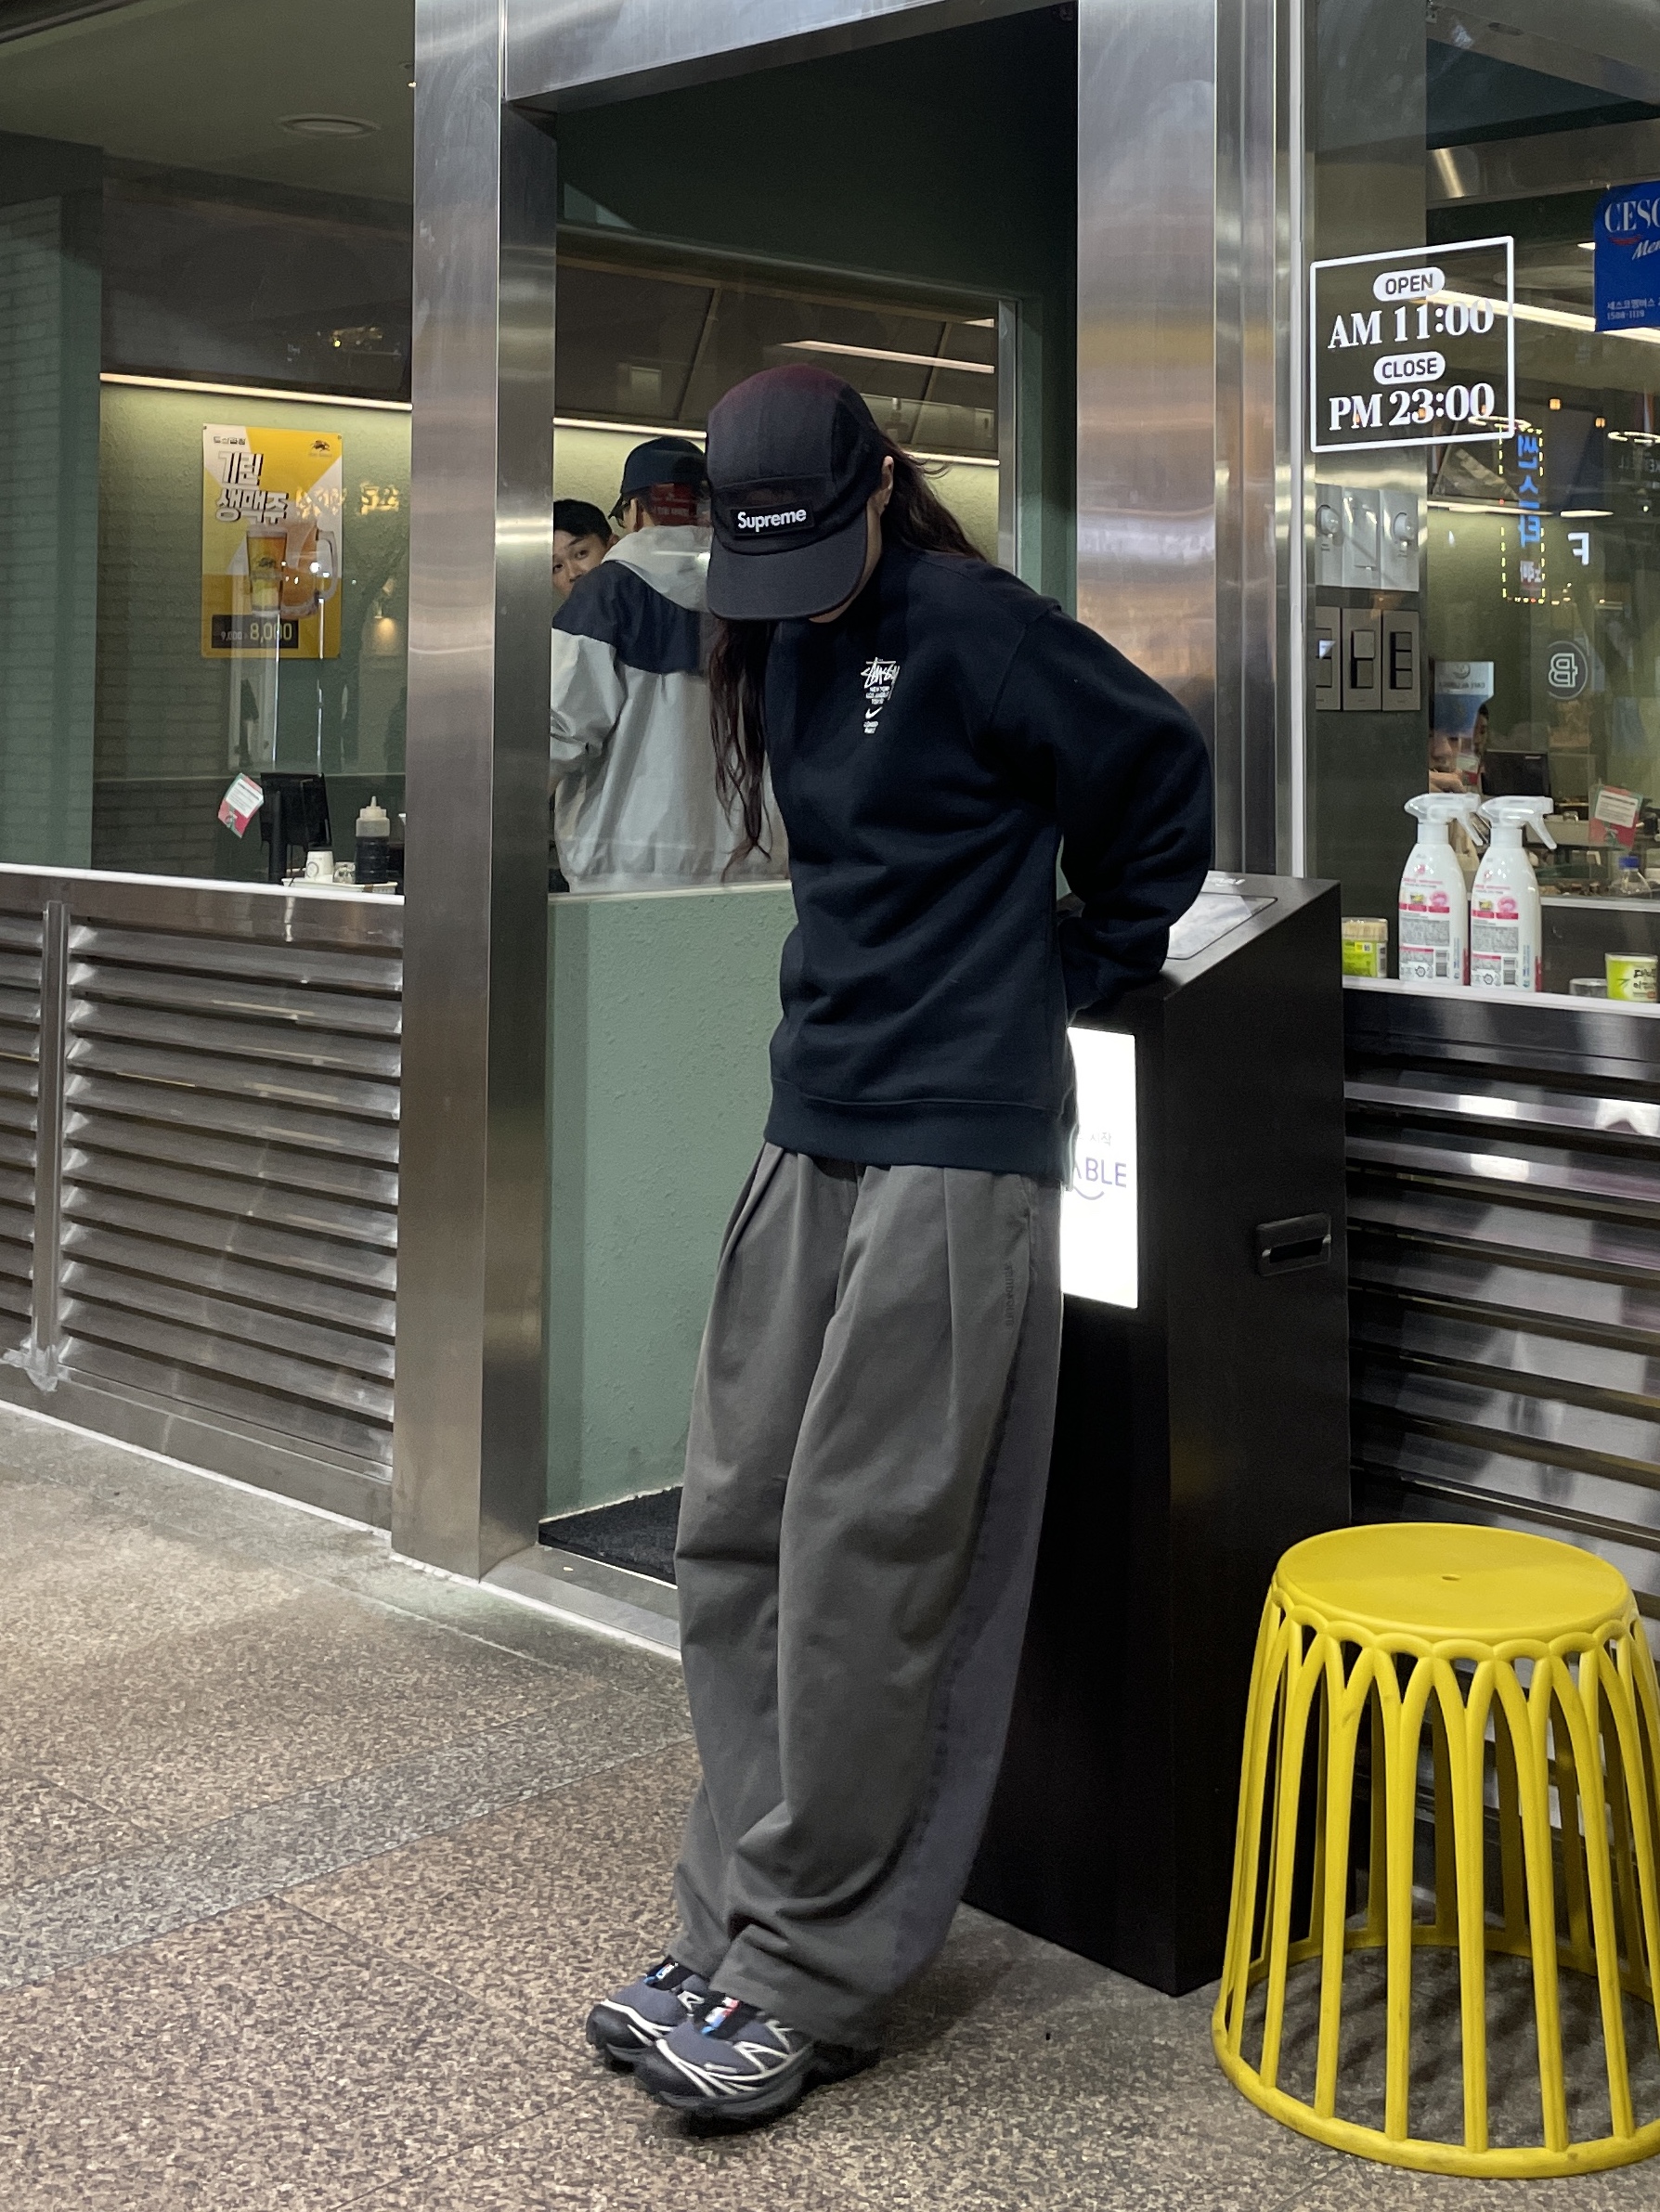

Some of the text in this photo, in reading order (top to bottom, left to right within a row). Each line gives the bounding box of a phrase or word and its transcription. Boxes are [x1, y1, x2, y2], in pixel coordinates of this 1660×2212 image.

[1384, 274, 1433, 295] OPEN
[1328, 298, 1495, 349] AM 11:00
[1381, 357, 1437, 379] CLOSE
[1329, 382, 1495, 431] PM 23:00
[217, 450, 264, 486] 기린
[215, 486, 289, 525] 생맥주
[737, 509, 807, 533] Supreme
[250, 622, 292, 643] 8,000
